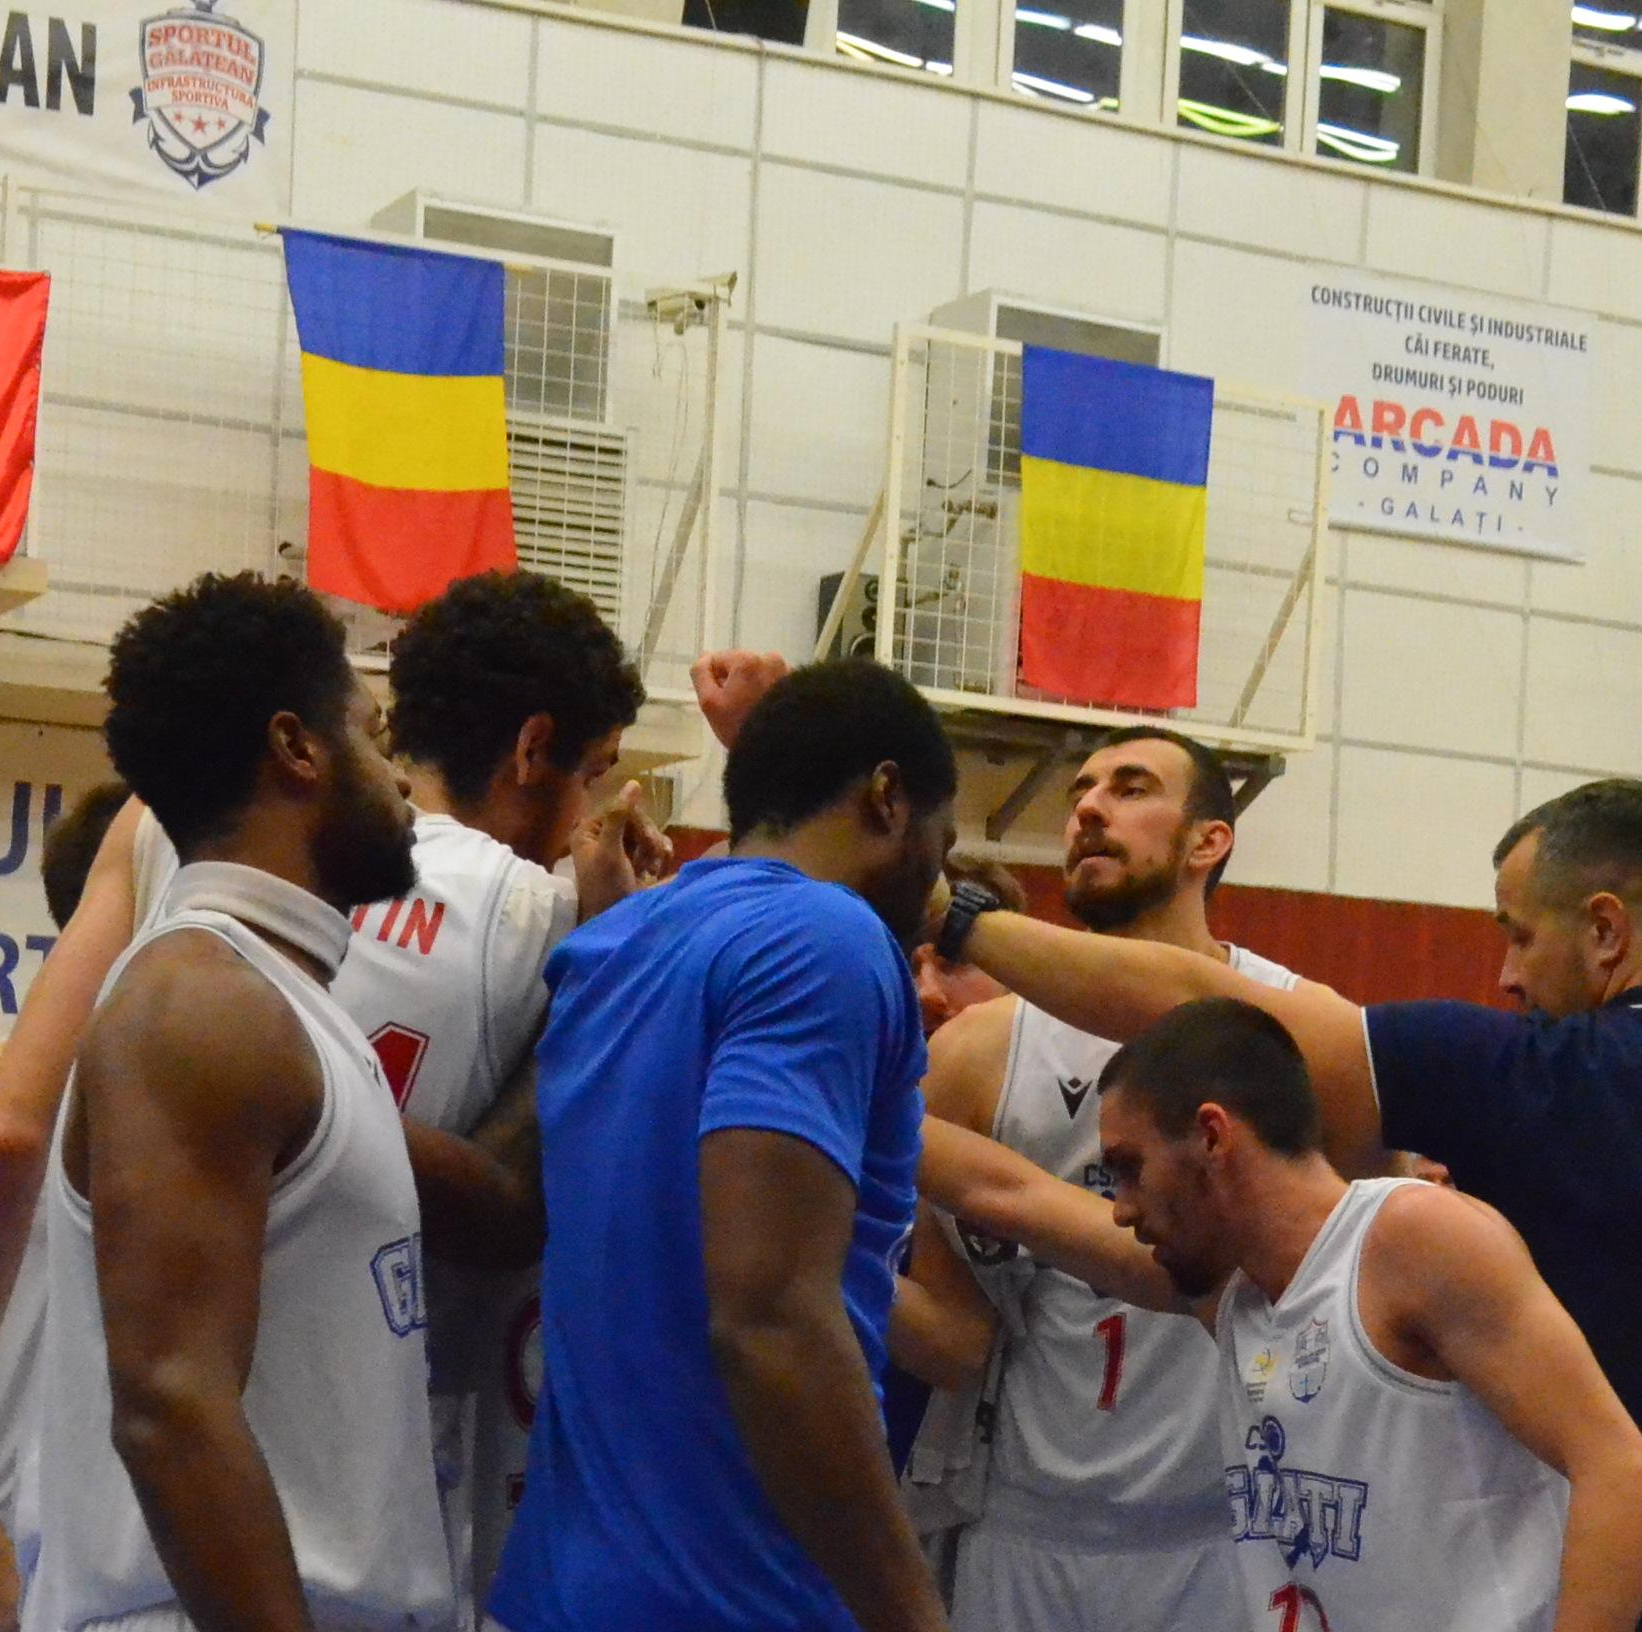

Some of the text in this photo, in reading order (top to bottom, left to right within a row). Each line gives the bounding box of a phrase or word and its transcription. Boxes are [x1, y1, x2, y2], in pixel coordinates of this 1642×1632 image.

[1311, 285, 1588, 352] CONSTRUCȚII CIVILE ȘI INDUSTRIALE
[1372, 362, 1525, 406] DRUMURI ȘI PODURI
[1433, 340, 1495, 371] FERATE,
[1332, 393, 1561, 479] ARCADA
[1092, 1312, 1127, 1413] 1
